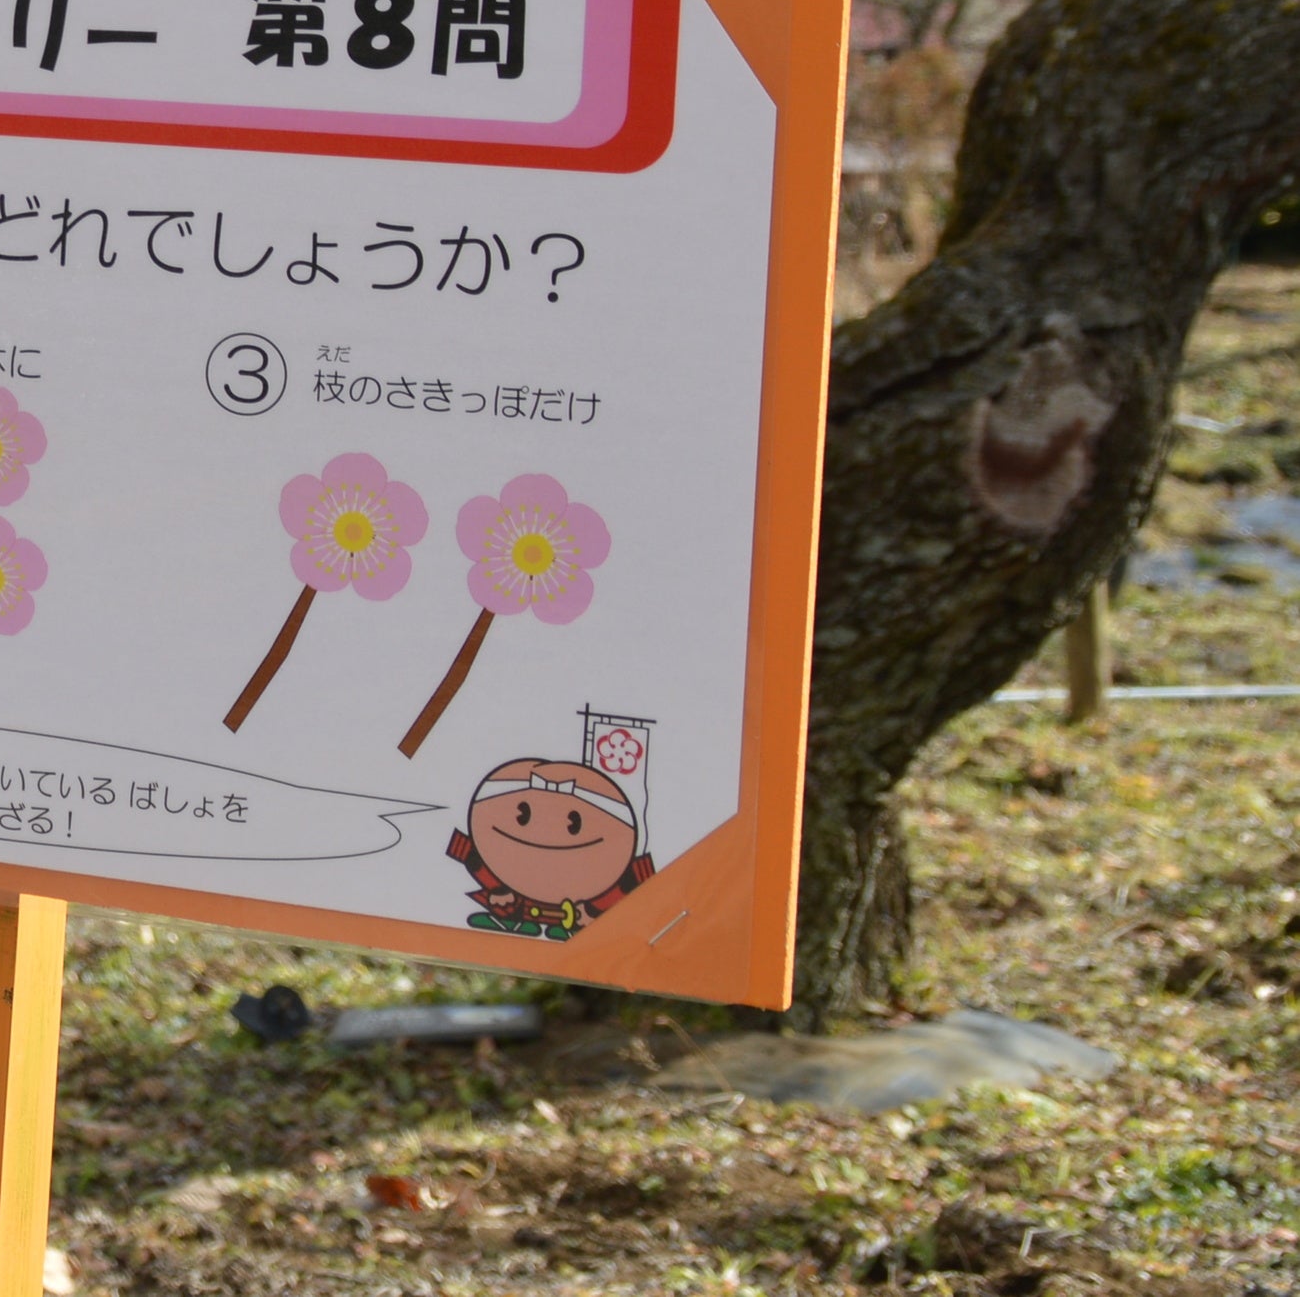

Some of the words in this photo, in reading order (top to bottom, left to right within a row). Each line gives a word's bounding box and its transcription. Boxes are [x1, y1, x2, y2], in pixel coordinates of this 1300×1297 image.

[317, 345, 351, 363] えだ
[313, 369, 601, 424] 枝のさきっぽだけ
